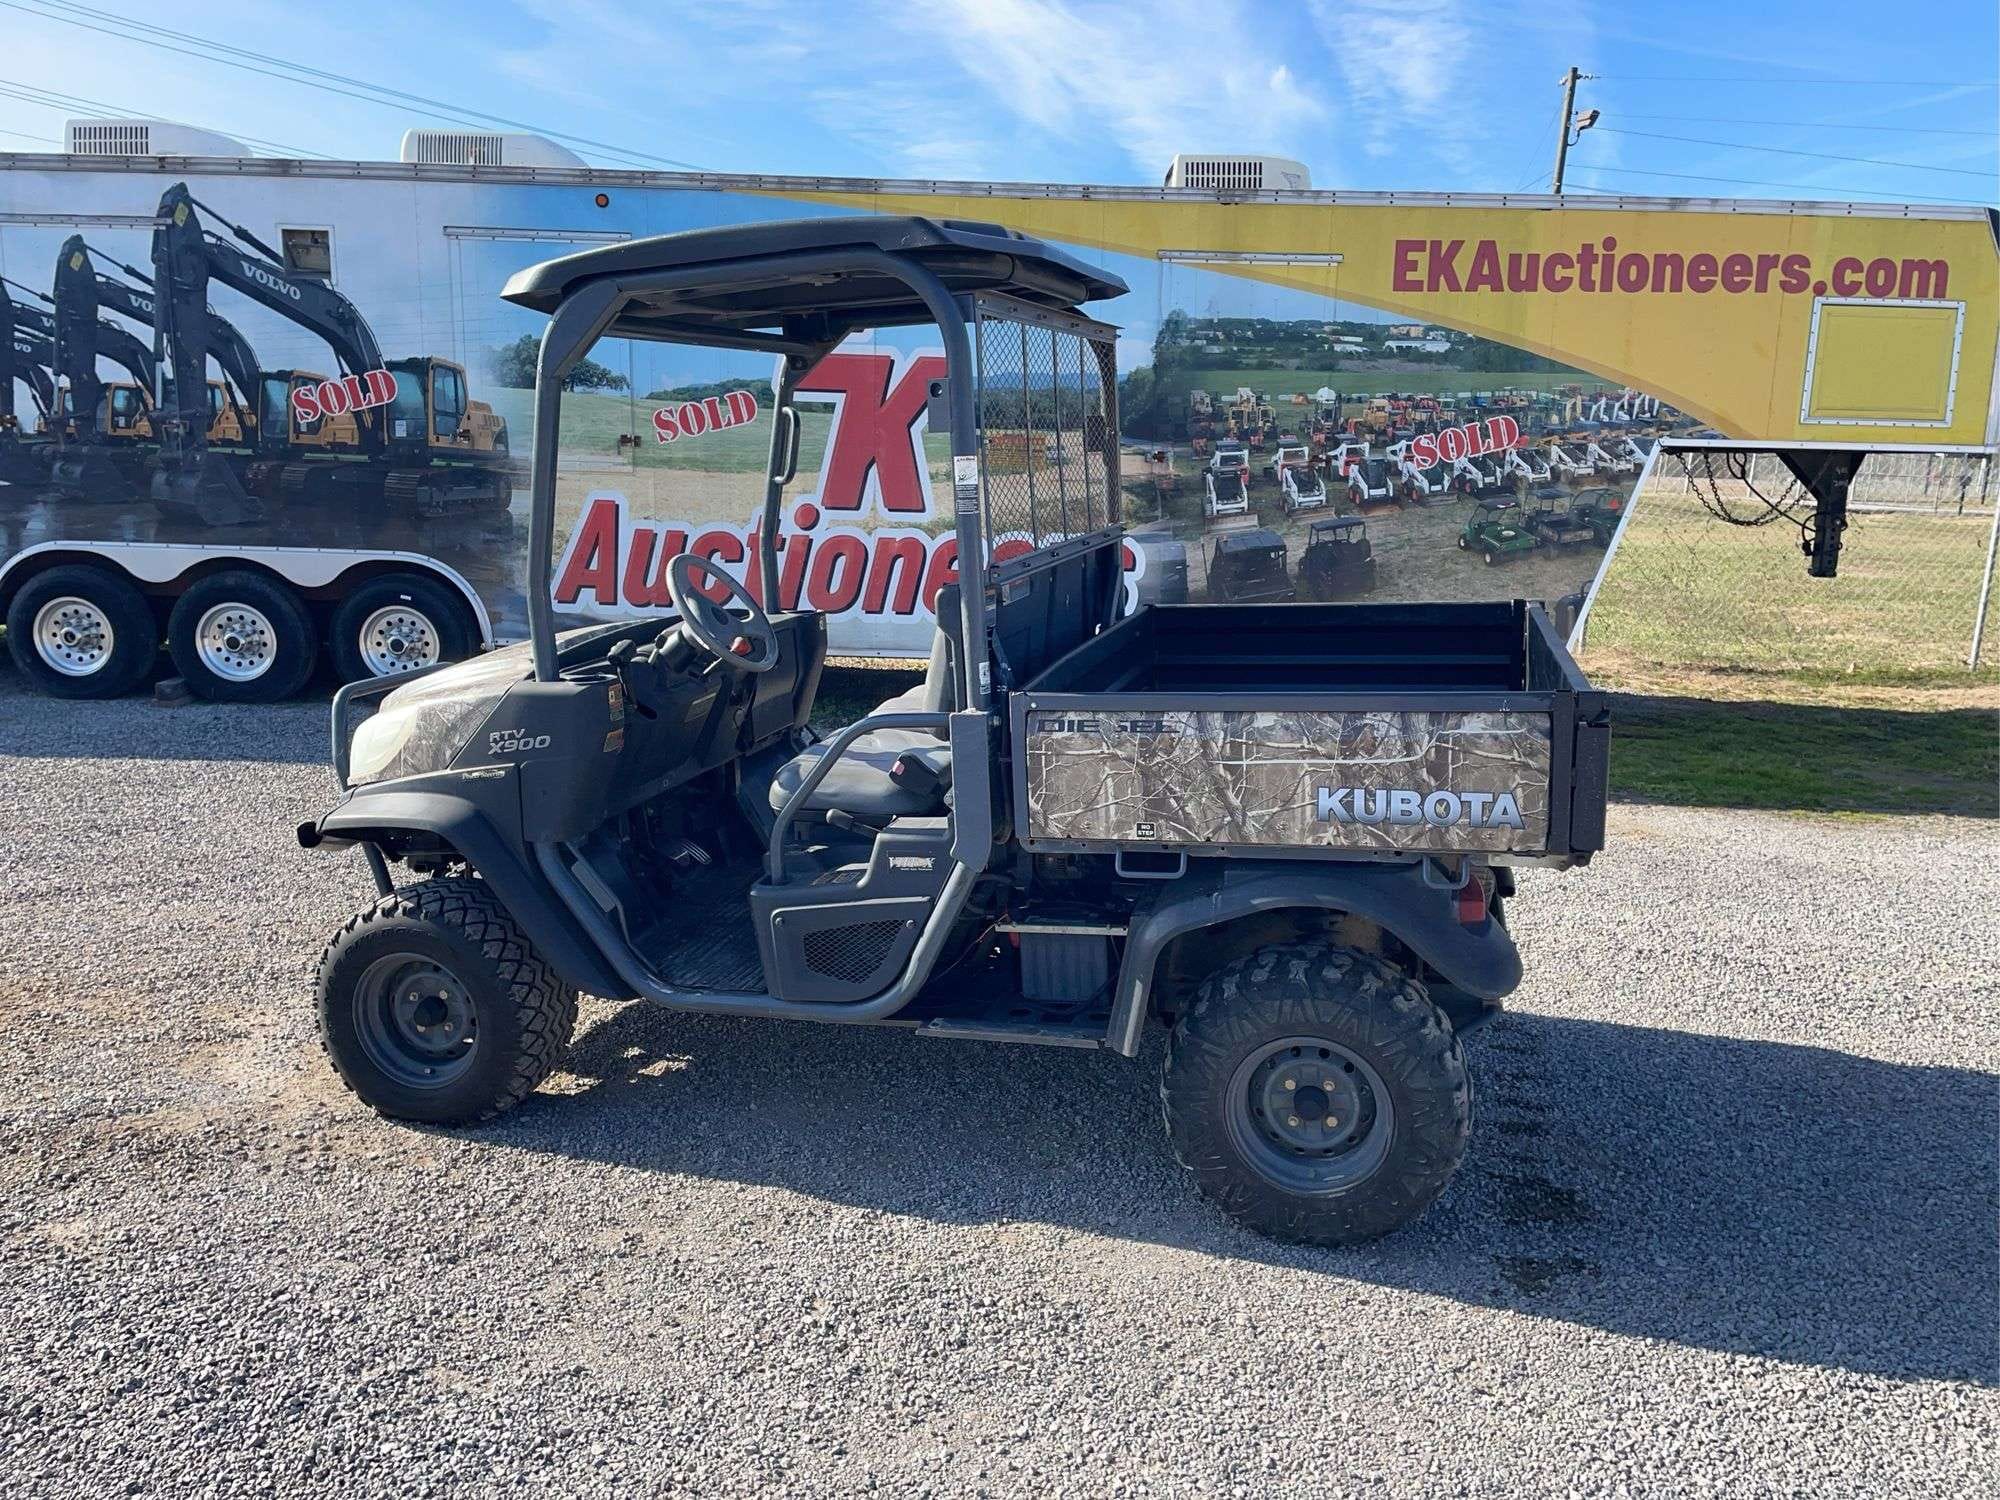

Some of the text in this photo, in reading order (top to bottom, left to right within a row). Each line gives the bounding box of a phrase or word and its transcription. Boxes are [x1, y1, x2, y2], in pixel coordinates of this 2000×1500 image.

[240, 261, 301, 300] VOLVO
[1392, 236, 1949, 299] EKAuctioneers.com
[292, 369, 398, 423] SOLD
[653, 391, 758, 444] SOLD
[1412, 415, 1519, 470] SOLD
[488, 735, 551, 755] X900
[489, 728, 526, 743] RTV
[1317, 786, 1525, 830] KUBOTA
